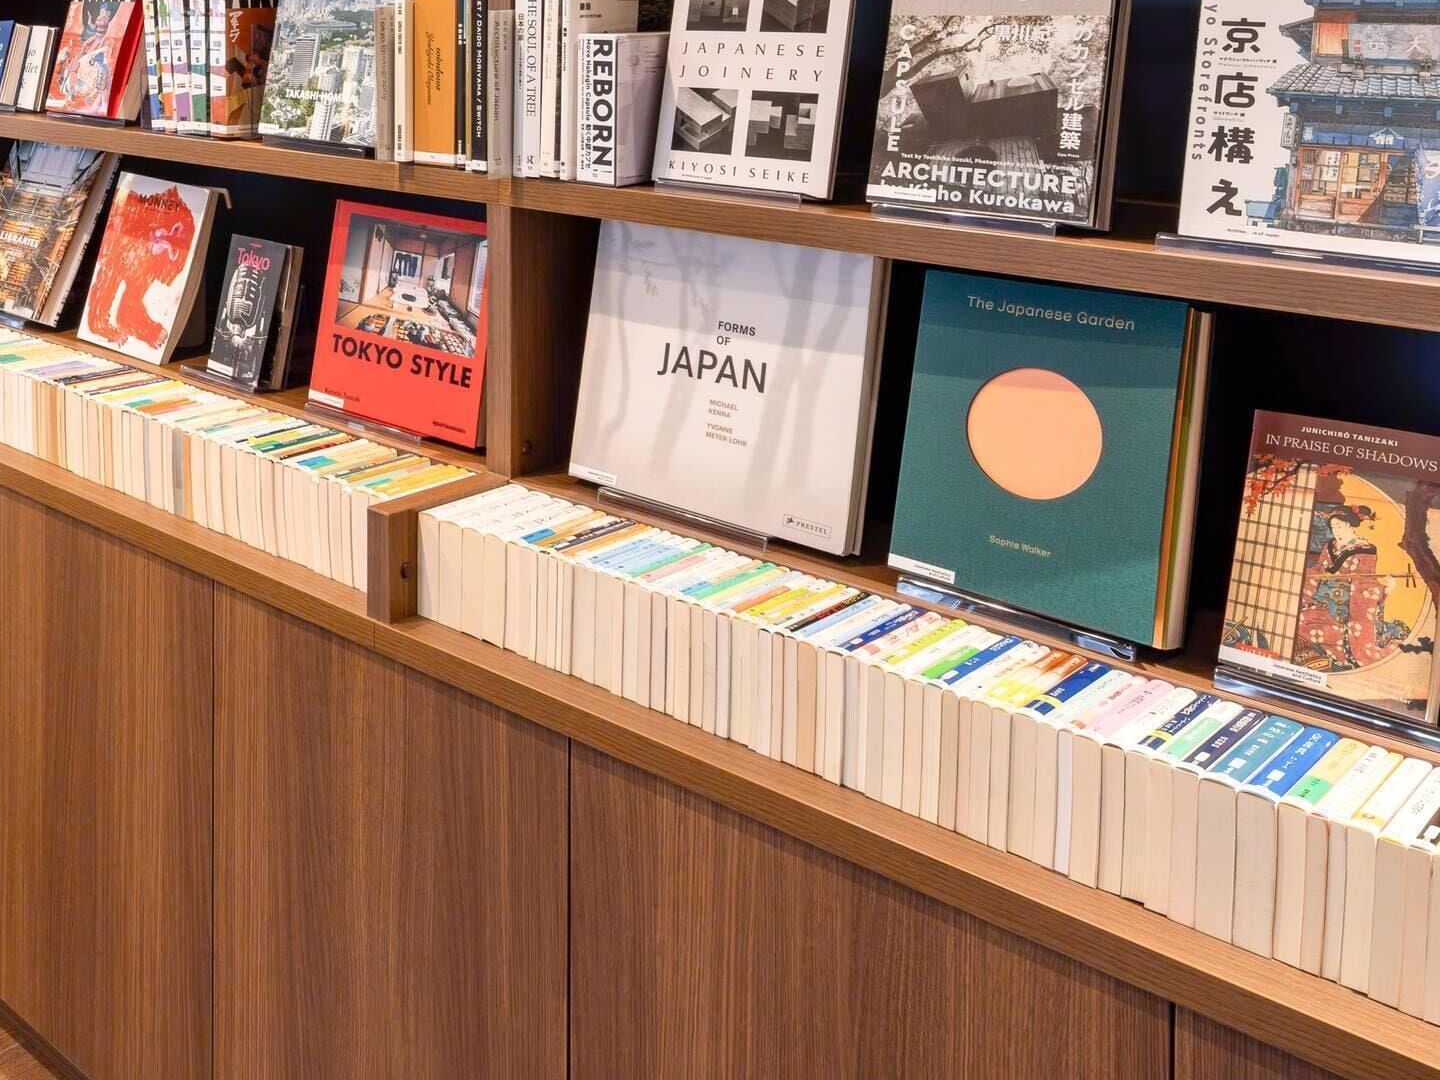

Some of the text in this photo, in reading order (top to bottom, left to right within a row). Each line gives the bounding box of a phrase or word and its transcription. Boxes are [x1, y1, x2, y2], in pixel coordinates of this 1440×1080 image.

[527, 19, 537, 53] SOUL
[681, 41, 827, 59] JAPANESE
[434, 47, 443, 92] windows
[493, 20, 501, 122] Architecture Japan
[527, 54, 537, 74] OF
[679, 64, 824, 83] JOINERY
[527, 74, 537, 84] A
[886, 24, 917, 153] CAPSULE
[285, 88, 321, 101] TAKASHI
[526, 85, 536, 118] TREE
[592, 39, 613, 167] REBORN
[1191, 36, 1219, 161] Storefronts
[667, 159, 810, 184] KIYOSI SEIKE
[900, 151, 1016, 168] Text by Photography
[880, 161, 1078, 195] ARCHITECTURE
[137, 193, 182, 211] MONKEY
[969, 189, 1075, 214] Kurokawa
[0, 230, 40, 249] LIBRARIES
[236, 247, 272, 272] Tokyo
[967, 295, 1136, 331] The Japanese Garden
[716, 335, 731, 346] OF
[717, 321, 756, 336] FORMS
[331, 333, 474, 389] TOKYO STYLE
[656, 342, 767, 394] JAPAN
[708, 408, 731, 418] KENNA
[709, 399, 739, 411] MICHAEL
[706, 423, 733, 434] YVONNE
[1352, 432, 1399, 447] TANIZAKI
[1265, 433, 1438, 472] IN PRAISE OF SHADOWS
[795, 520, 830, 536] PRESTEL
[988, 534, 1052, 558] Sophie Walker
